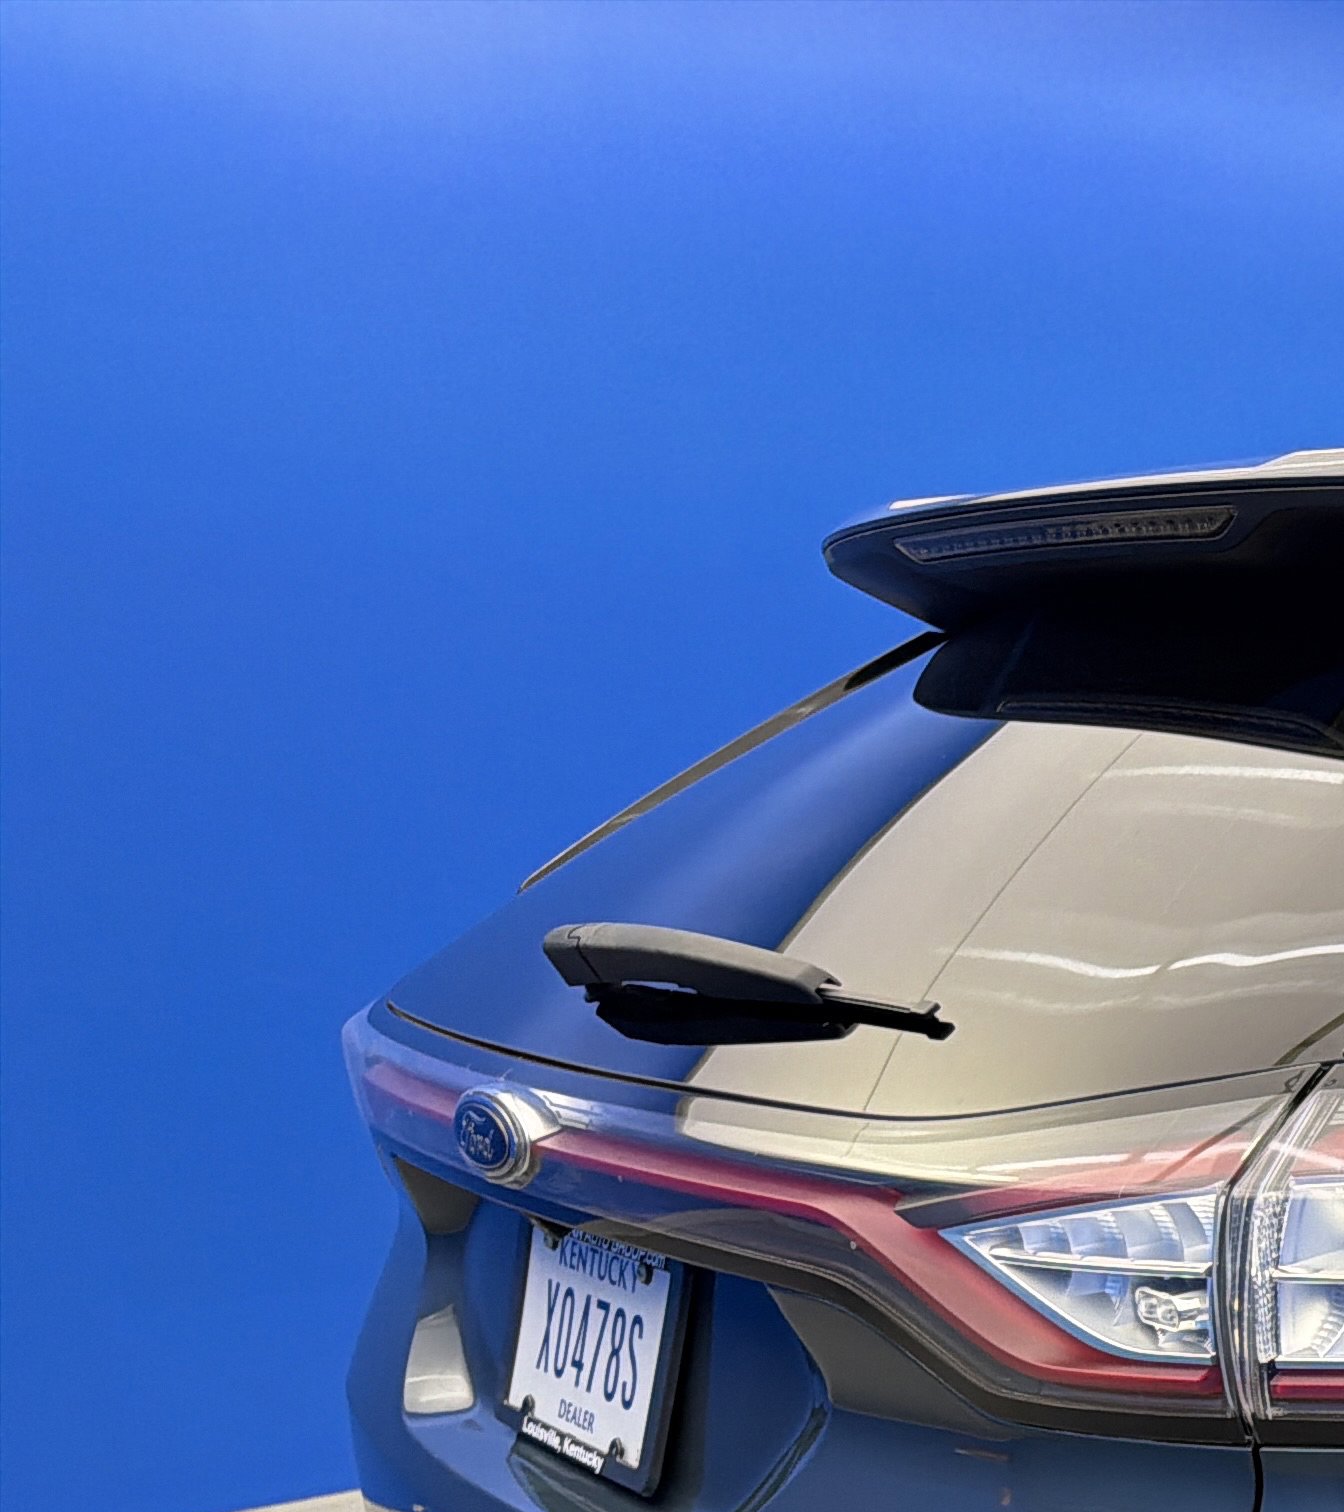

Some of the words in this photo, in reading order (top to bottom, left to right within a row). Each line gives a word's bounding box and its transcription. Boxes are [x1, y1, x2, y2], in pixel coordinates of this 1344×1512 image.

[460, 1110, 495, 1161] Ford
[559, 1240, 638, 1294] KENTUCKY
[536, 1278, 644, 1411] X0478S
[557, 1398, 595, 1435] DEALER
[521, 1415, 561, 1455] Louisville,
[562, 1436, 605, 1475] Kentucky
